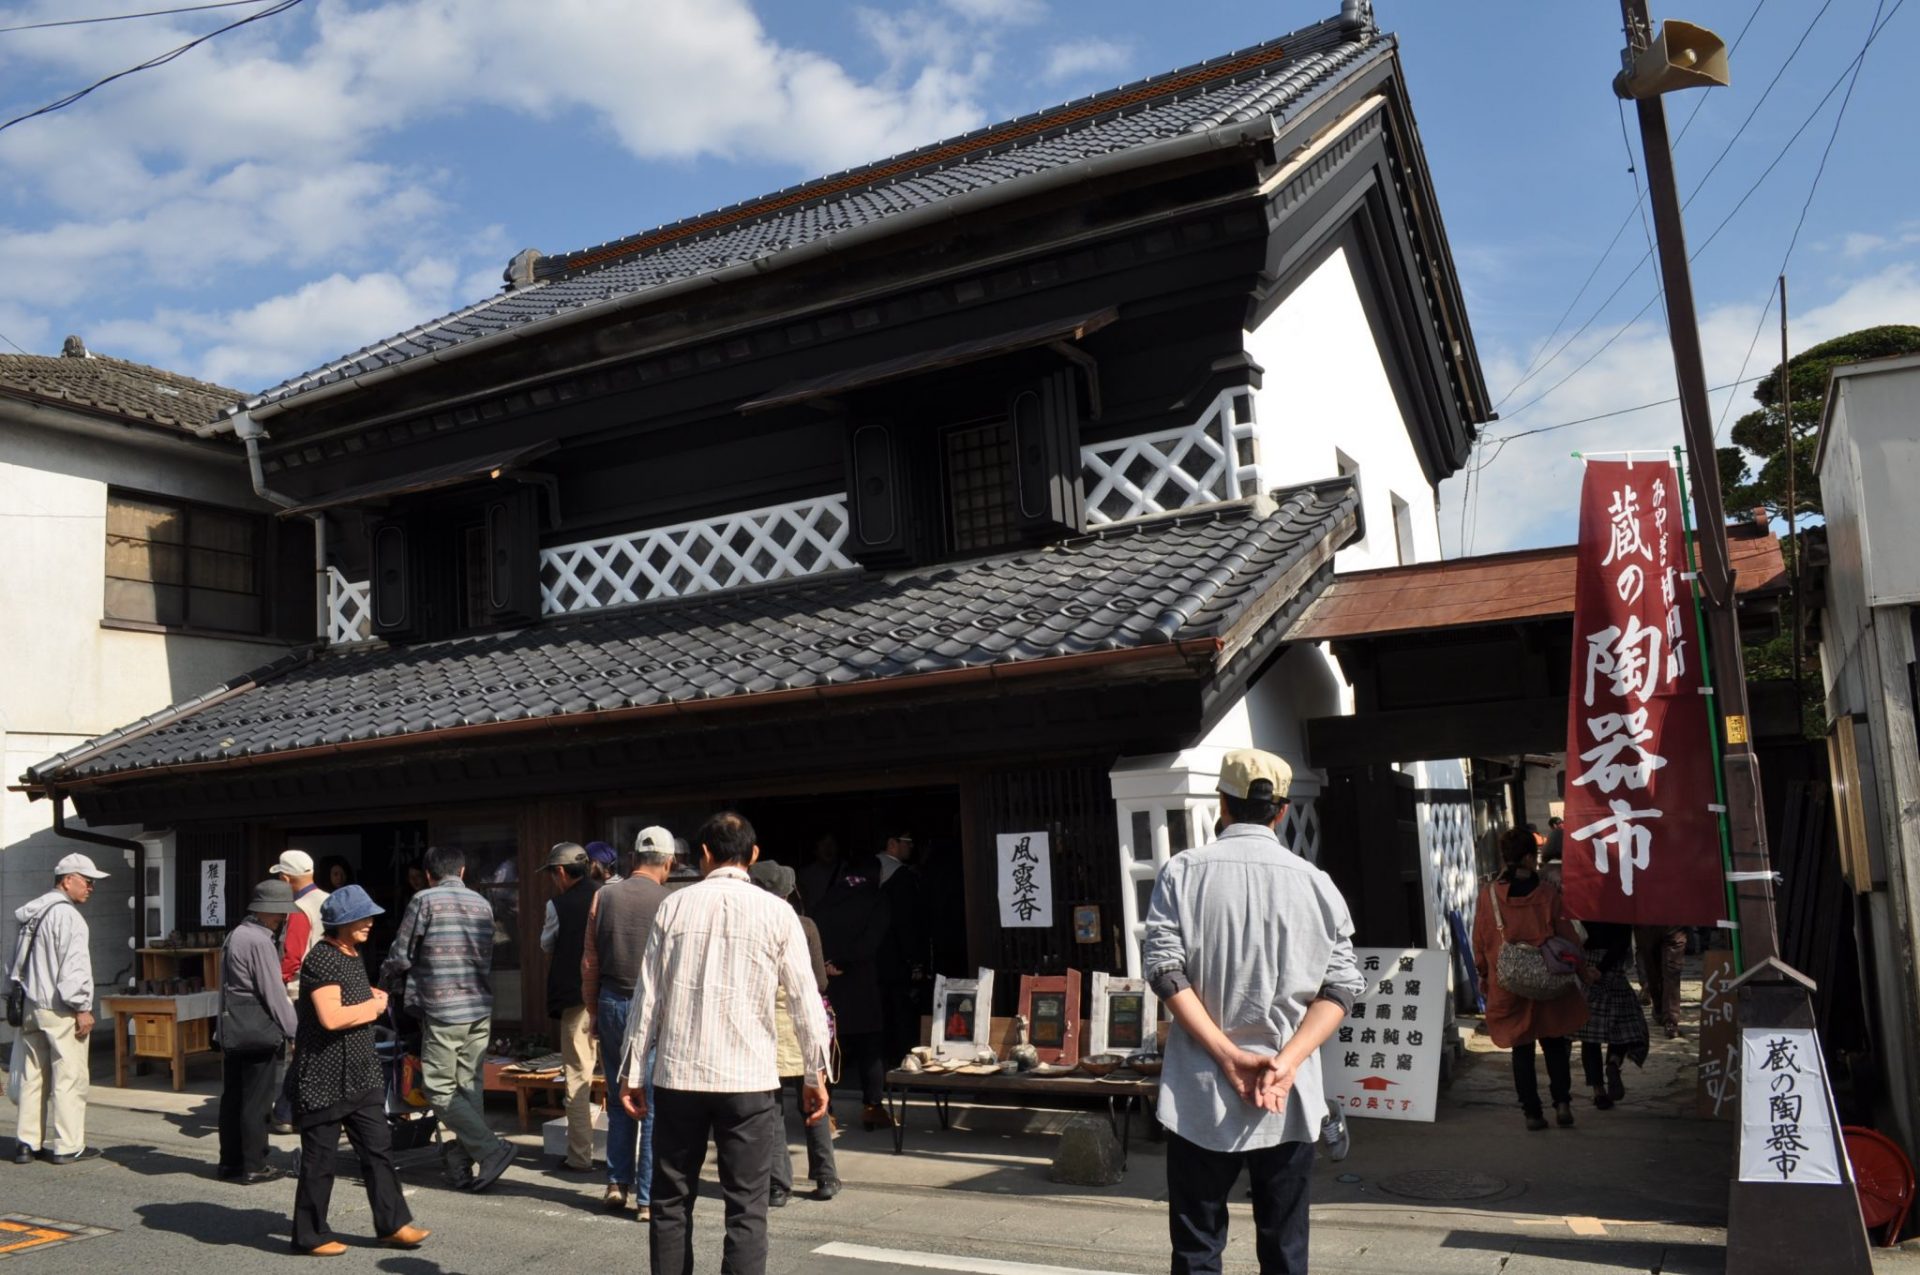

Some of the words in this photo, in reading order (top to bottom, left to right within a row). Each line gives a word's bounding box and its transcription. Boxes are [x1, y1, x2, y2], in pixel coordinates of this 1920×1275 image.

[1570, 485, 1668, 897] 蔵の陶器市
[1011, 836, 1041, 921] 風露香
[1760, 1036, 1809, 1180] 蔵の陶器市
